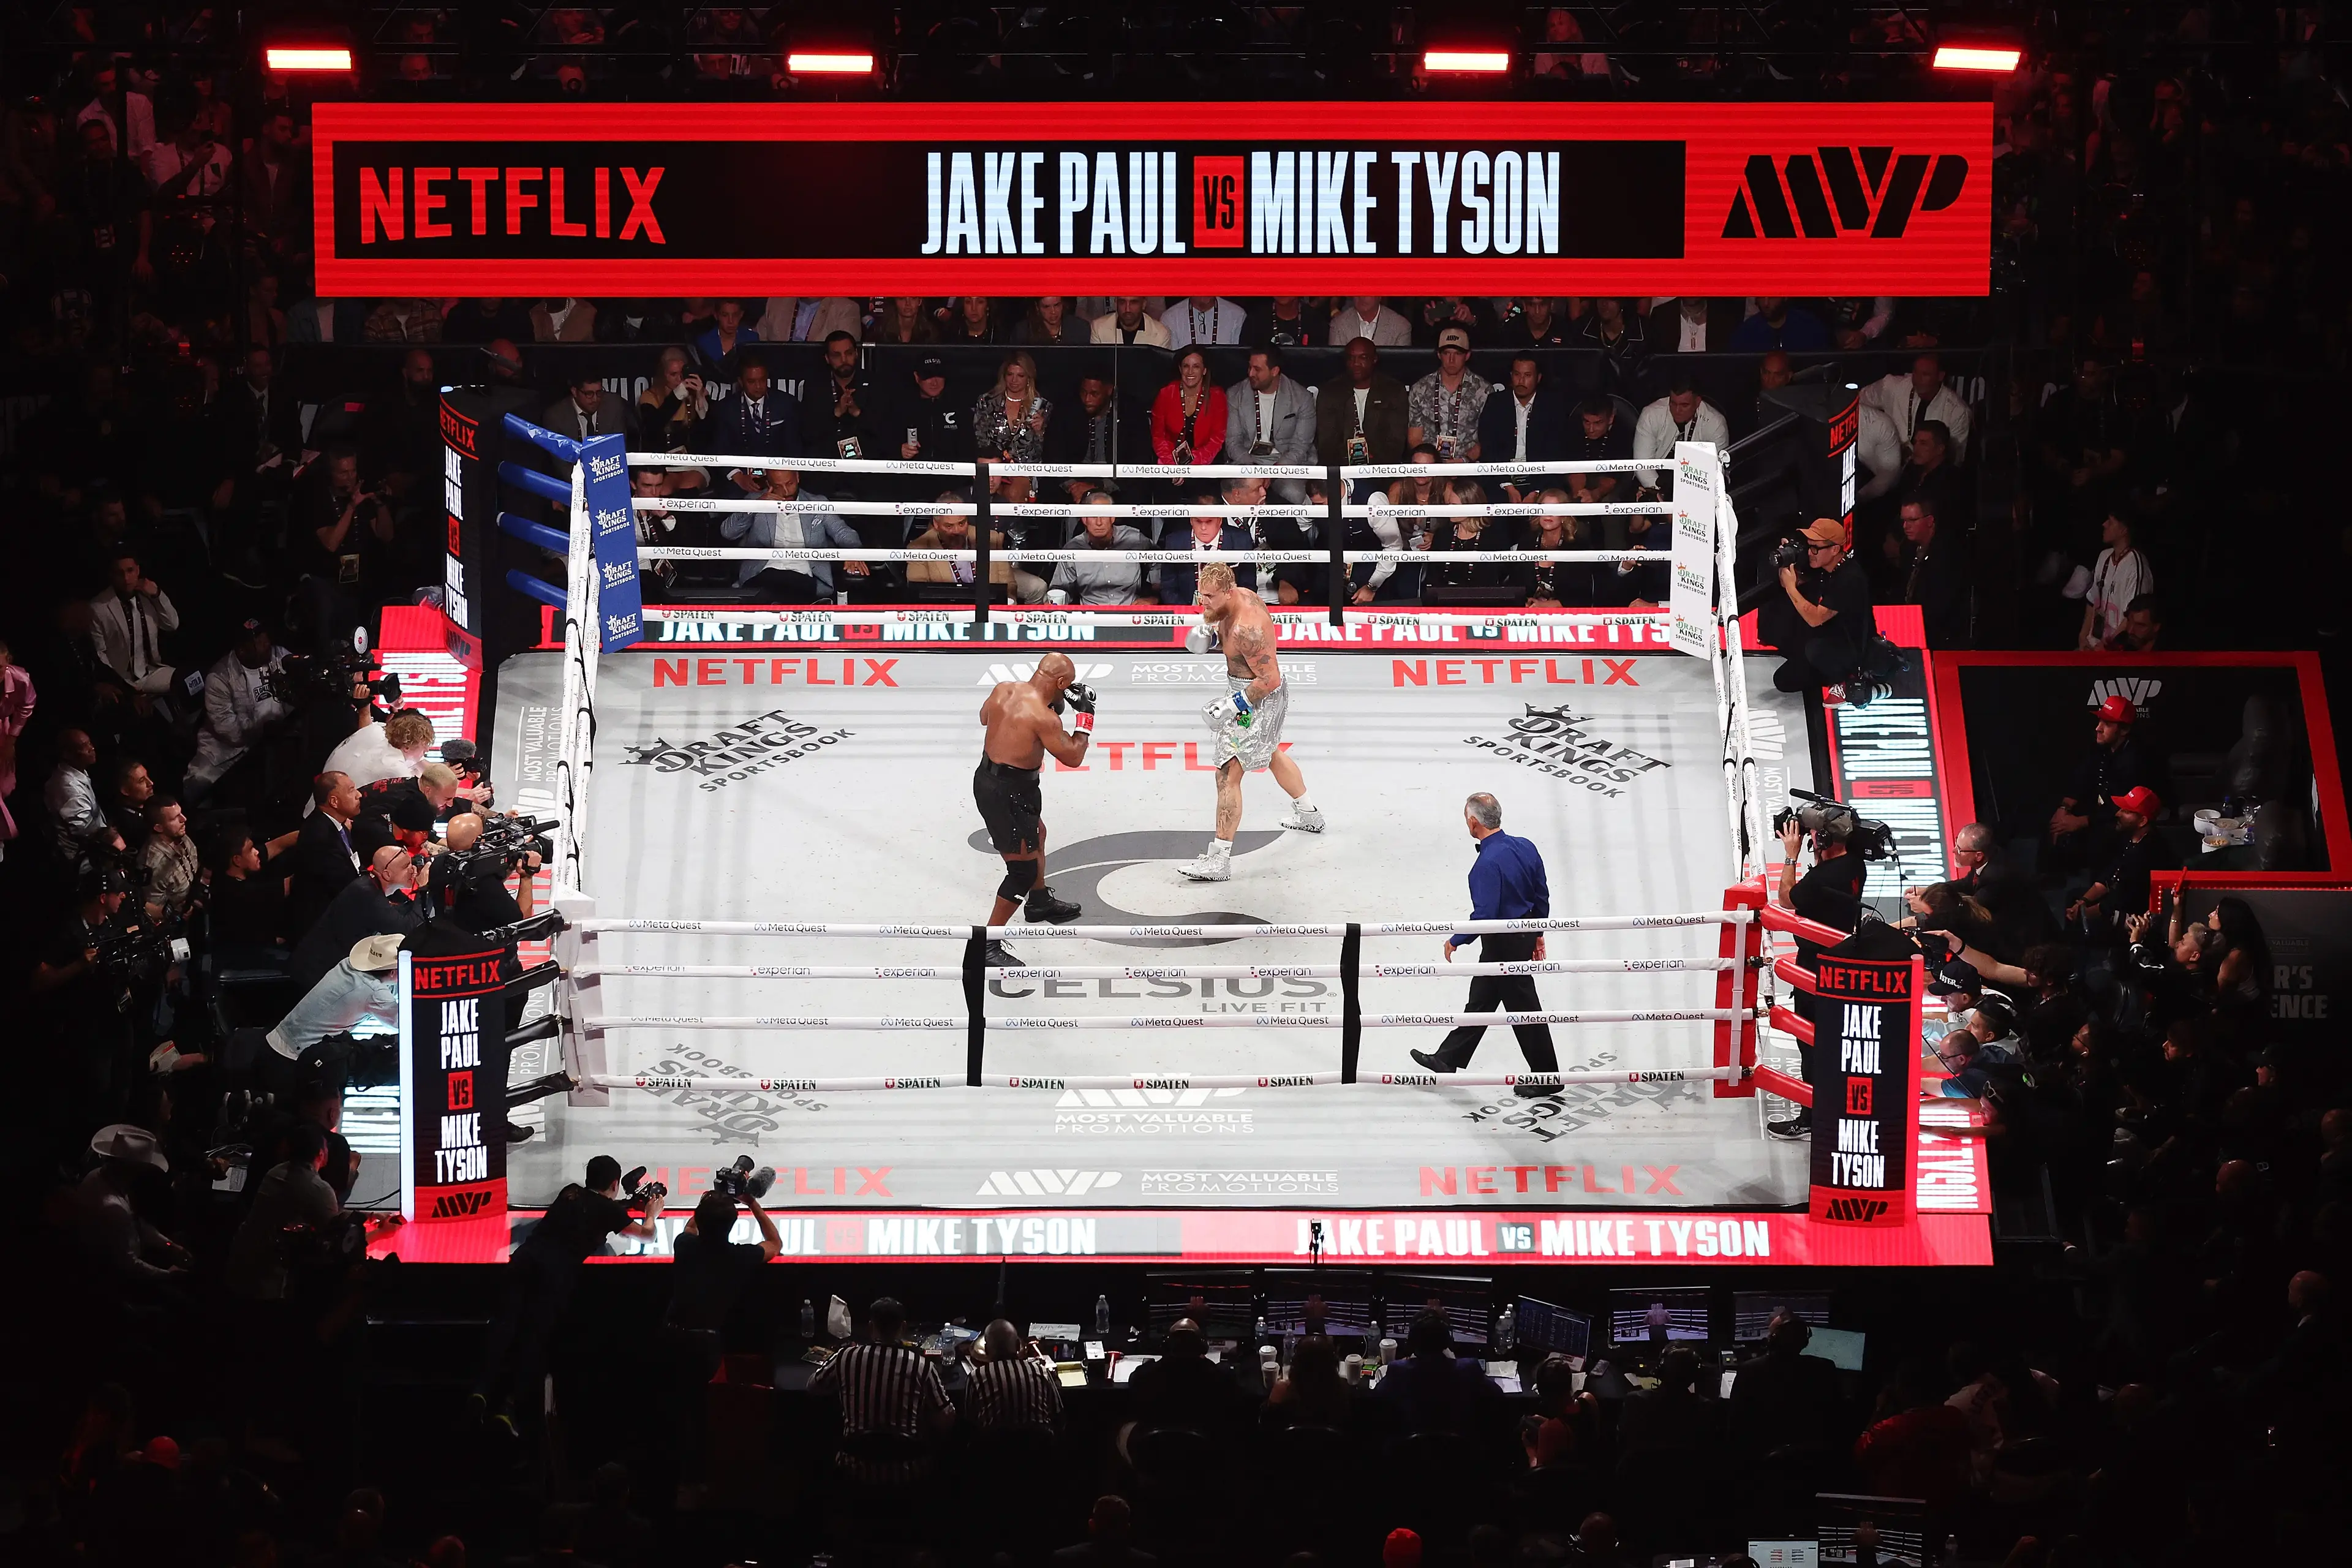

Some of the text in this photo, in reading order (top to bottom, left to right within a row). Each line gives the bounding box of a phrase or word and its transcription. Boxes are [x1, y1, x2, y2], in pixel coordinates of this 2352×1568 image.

[1721, 146, 1969, 238] MVP
[360, 167, 666, 244] NETFLIX
[921, 151, 1560, 254] JAKE PAUL VS MIKE TYSON
[445, 445, 462, 487] JAKE
[591, 455, 620, 472] DRAFT
[597, 463, 620, 476] KINGS
[809, 458, 837, 468] Quest
[593, 469, 624, 484] SPORTSBOOK
[1681, 464, 1708, 478] DRAFT
[1680, 478, 1709, 491] SPORTSBOOK
[1684, 472, 1708, 485] KINGS
[445, 479, 463, 521] PAUL
[667, 500, 715, 509] experian
[785, 503, 834, 512] experian
[903, 505, 953, 516] experian
[1613, 505, 1662, 513] experian
[598, 508, 627, 525] DRAFT
[603, 516, 627, 529] KINGS
[1679, 516, 1707, 530] DRAFT
[600, 521, 630, 537] SPORTSBOOK
[1683, 524, 1706, 537] KINGS
[1679, 530, 1708, 544] SPORTSBOOK
[446, 552, 464, 595] MIKE
[604, 561, 633, 578] DRAFT
[608, 569, 633, 582] KINGS
[1678, 569, 1705, 582] DRAFT
[605, 575, 635, 589] SPORTSBOOK
[1677, 582, 1706, 596] SPORTSBOOK
[1681, 576, 1704, 589] KINGS
[445, 587, 468, 630] TYSON
[608, 614, 636, 630] DRAFT
[791, 612, 832, 622] SPATEN
[909, 611, 949, 621] SPATEN
[1379, 616, 1420, 625] SPATEN
[1615, 616, 1656, 625] SPATEN
[609, 621, 636, 635] KINGS
[609, 627, 639, 642] SPORTSBOOK
[1676, 622, 1703, 635] DRAFT
[1679, 628, 1703, 641] KINGS
[1676, 635, 1705, 648] SPORTSBOOK
[653, 658, 899, 687] NETFLIX
[1132, 664, 1177, 673] MOST
[1392, 659, 1639, 687] NETFLIX
[2087, 677, 2162, 706] MVP
[524, 706, 547, 782] MOST VALUABLE
[655, 709, 793, 772] DRAFT
[1508, 717, 1672, 773] DRAFT
[692, 722, 819, 777] KINGS
[698, 728, 857, 792] SPORTSBOOK
[1503, 731, 1640, 783] KINGS
[1841, 738, 1932, 780] PAUL
[1463, 736, 1626, 798] SPORTSBOOK
[1763, 767, 1777, 793] MOST
[644, 921, 668, 930] Meta
[1423, 923, 1454, 932] Quest
[1646, 916, 1705, 926] Meta Quest
[1047, 928, 1077, 937] Quest
[1298, 926, 1329, 935] Quest
[1384, 967, 1435, 977] experian
[1508, 963, 1559, 974] experian
[1632, 960, 1684, 970] experian
[414, 960, 500, 990] NETFLIX
[883, 969, 935, 979] experian
[1008, 970, 1062, 979] experian
[1259, 968, 1313, 978] experian
[1819, 965, 1907, 993] NETFLIX
[987, 978, 1328, 998] CELSIUS
[1202, 1003, 1326, 1012] LIVE FIT
[440, 998, 480, 1035] JAKE
[1173, 1018, 1204, 1027] Quest
[1298, 1017, 1329, 1025] Quest
[1424, 1015, 1454, 1024] Quest
[1841, 1003, 1882, 1039] JAKE
[440, 1036, 481, 1069] PAUL
[1841, 1038, 1882, 1074] PAUL
[897, 1077, 940, 1089] SPATEN
[1022, 1079, 1065, 1090] SPATEN
[1146, 1079, 1189, 1090] SPATEN
[1270, 1076, 1313, 1087] SPATEN
[1394, 1075, 1436, 1086] SPATEN
[1518, 1075, 1561, 1085] SPATEN
[1642, 1072, 1684, 1083] SPATEN
[453, 1078, 469, 1106] VS
[773, 1079, 816, 1091] SPATEN
[1852, 1084, 1868, 1110] VS
[1055, 1114, 1253, 1123] MOST VALUABLE
[441, 1112, 481, 1150] MIKE
[1055, 1125, 1254, 1133] PROMOTIONS
[1838, 1118, 1879, 1154] MIKE
[434, 1145, 488, 1183] TYSON
[1831, 1152, 1885, 1188] TYSON
[975, 1170, 1123, 1196] MVP
[1142, 1173, 1338, 1182] MOST VALUABLE
[1419, 1166, 1684, 1196] NETFLIX
[1917, 1150, 1979, 1210] TYSON
[1142, 1183, 1338, 1192] PROMOTIONS
[431, 1191, 492, 1219] MVP
[1825, 1197, 1888, 1223] MVP
[868, 1218, 1096, 1254] MIKE TYSON
[1294, 1218, 1770, 1257] JAKE PAUL VS MIKE TYSON
